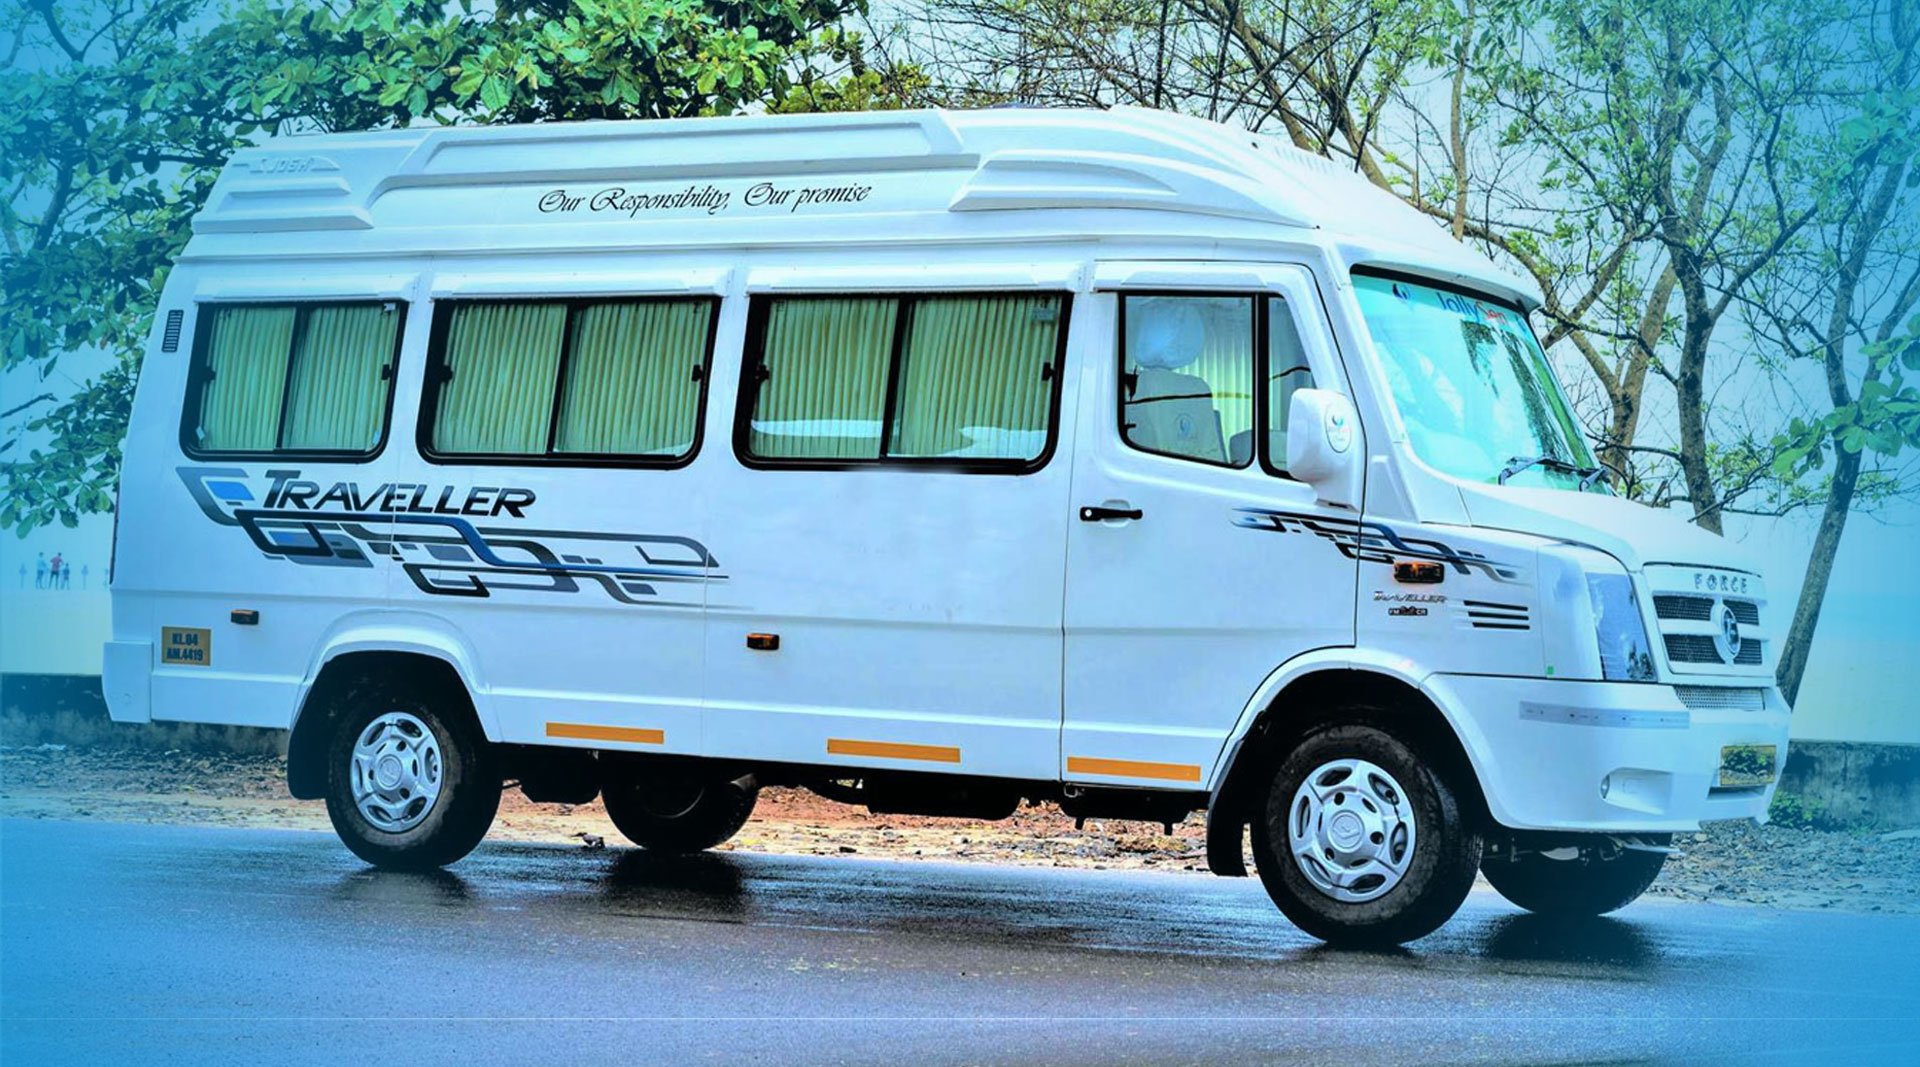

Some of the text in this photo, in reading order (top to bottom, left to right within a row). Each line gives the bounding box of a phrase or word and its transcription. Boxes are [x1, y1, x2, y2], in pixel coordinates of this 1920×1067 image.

[538, 182, 872, 219] Our Responsibility, Our promise
[263, 469, 537, 518] TRAVELLER
[1694, 573, 1748, 594] FORCE
